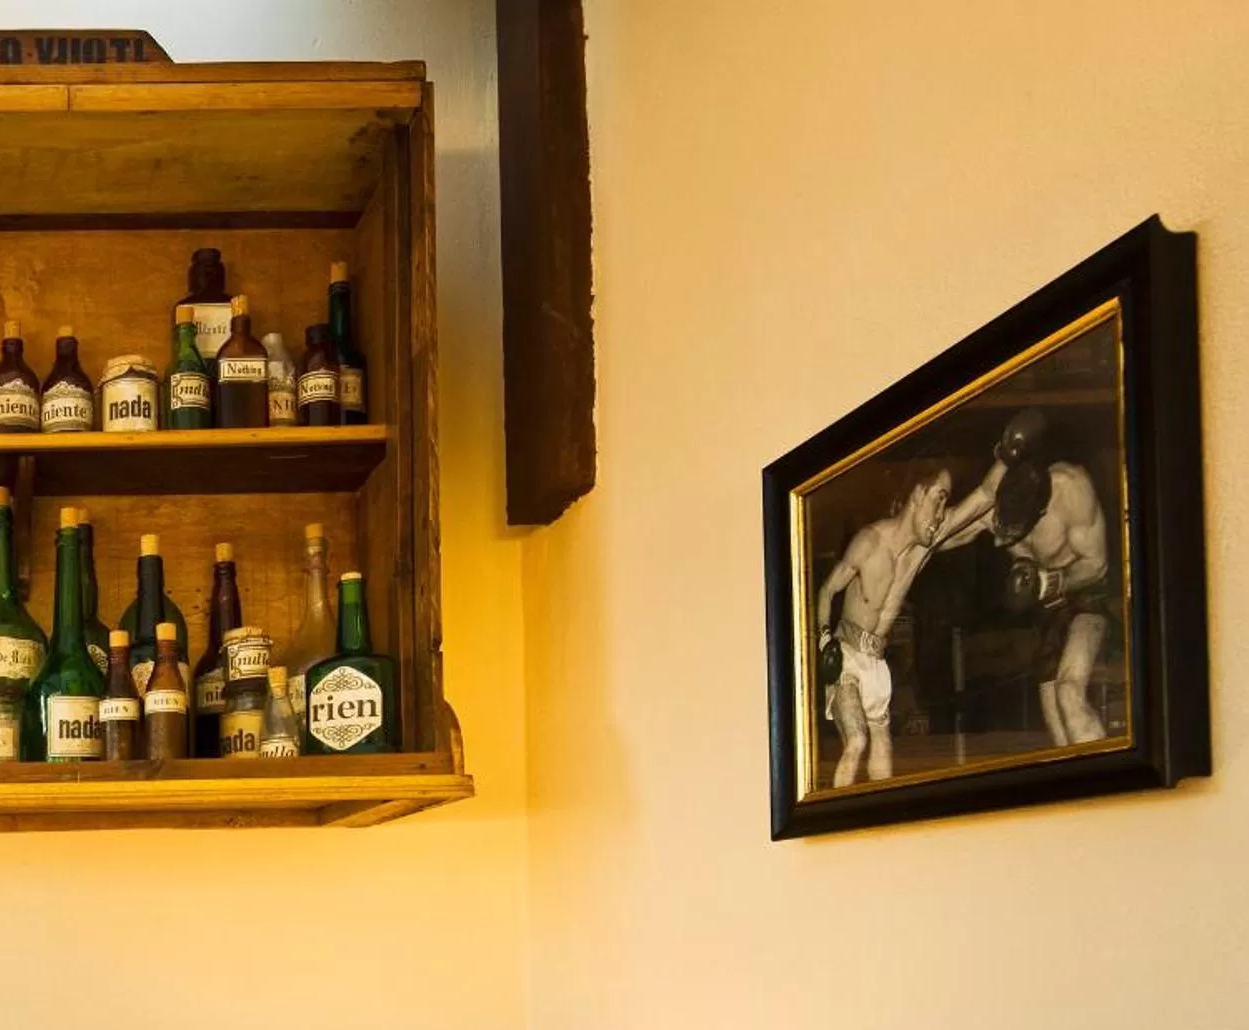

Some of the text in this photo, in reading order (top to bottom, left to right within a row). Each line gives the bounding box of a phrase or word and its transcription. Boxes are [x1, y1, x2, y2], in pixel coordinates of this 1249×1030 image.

[227, 362, 263, 375] Nothing
[44, 403, 88, 421] niente
[110, 394, 151, 421] nada
[312, 695, 378, 723] rien
[58, 714, 102, 740] nada
